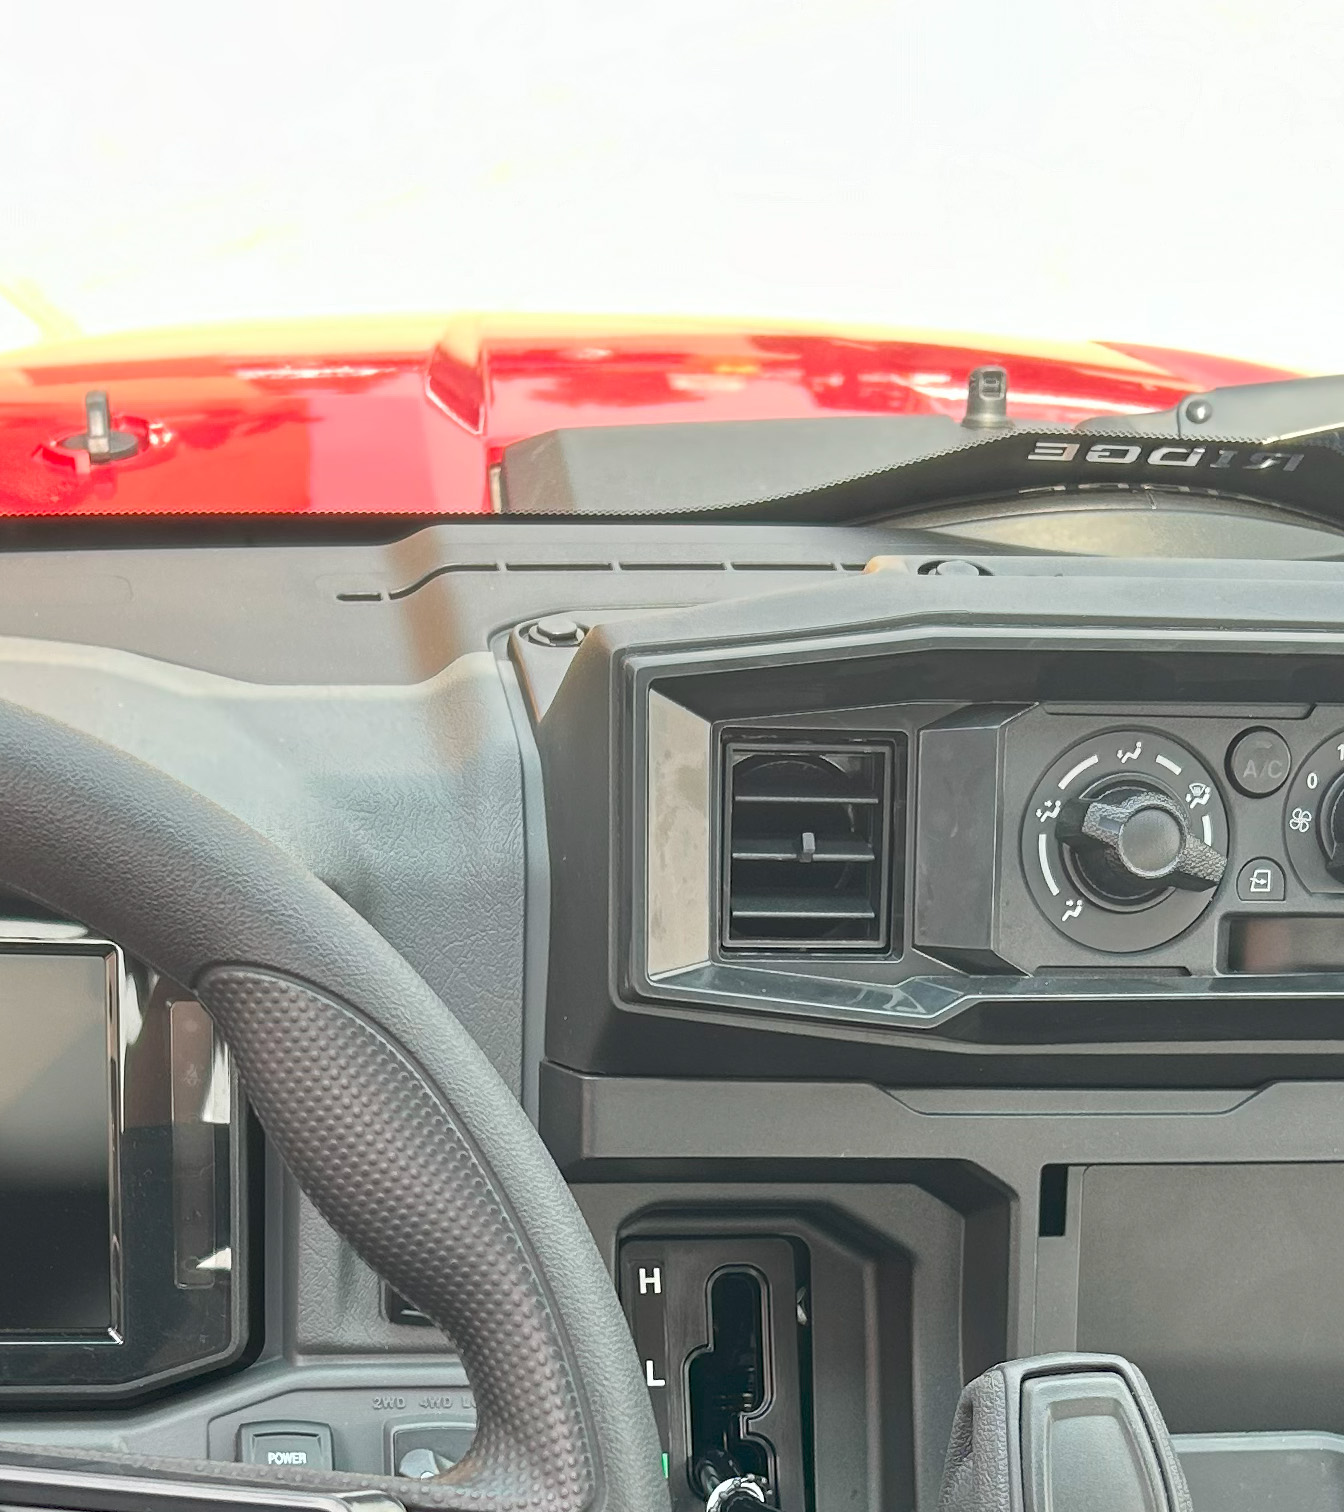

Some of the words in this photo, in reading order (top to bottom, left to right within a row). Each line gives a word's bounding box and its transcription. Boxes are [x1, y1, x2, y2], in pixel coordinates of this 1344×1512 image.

[1337, 743, 1344, 761] 1
[1242, 759, 1283, 778] A/C
[1307, 772, 1318, 789] 0
[638, 1267, 662, 1294] H
[645, 1360, 666, 1387] L
[372, 1397, 406, 1410] 2WD
[419, 1396, 453, 1409] 4WD
[267, 1451, 307, 1465] POWER
